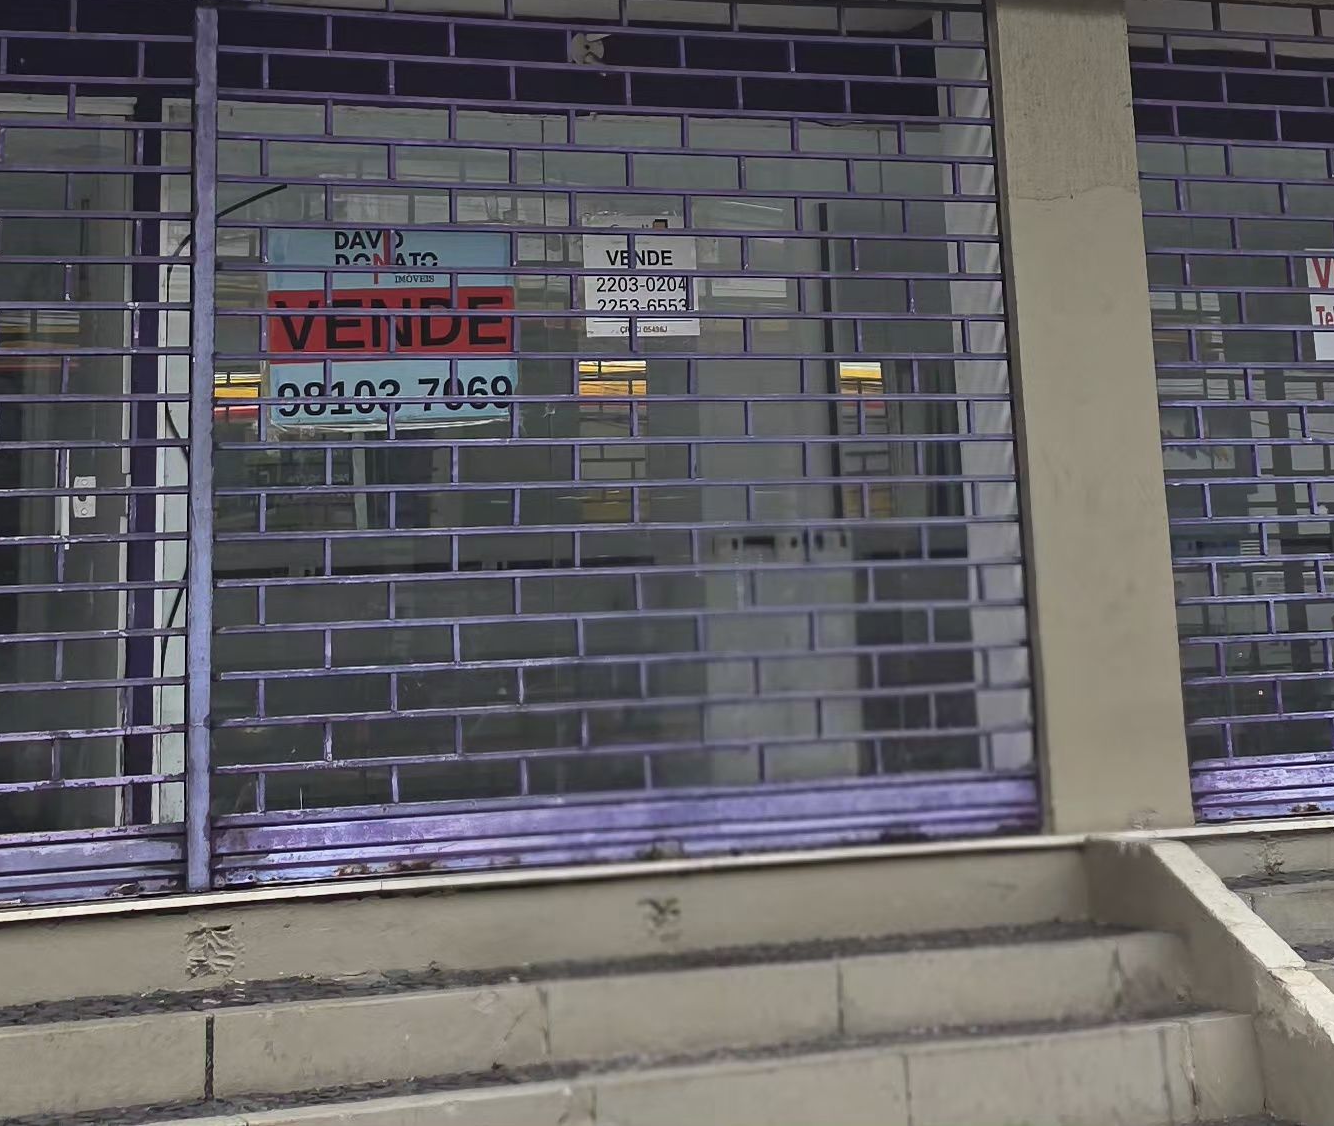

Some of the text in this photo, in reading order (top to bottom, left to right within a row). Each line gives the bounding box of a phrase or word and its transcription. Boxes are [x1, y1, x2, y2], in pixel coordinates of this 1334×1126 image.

[605, 250, 674, 266] VENDE
[596, 276, 687, 293] 2203-0204
[274, 296, 507, 351] VENDE
[277, 375, 513, 417] 98103 7069
